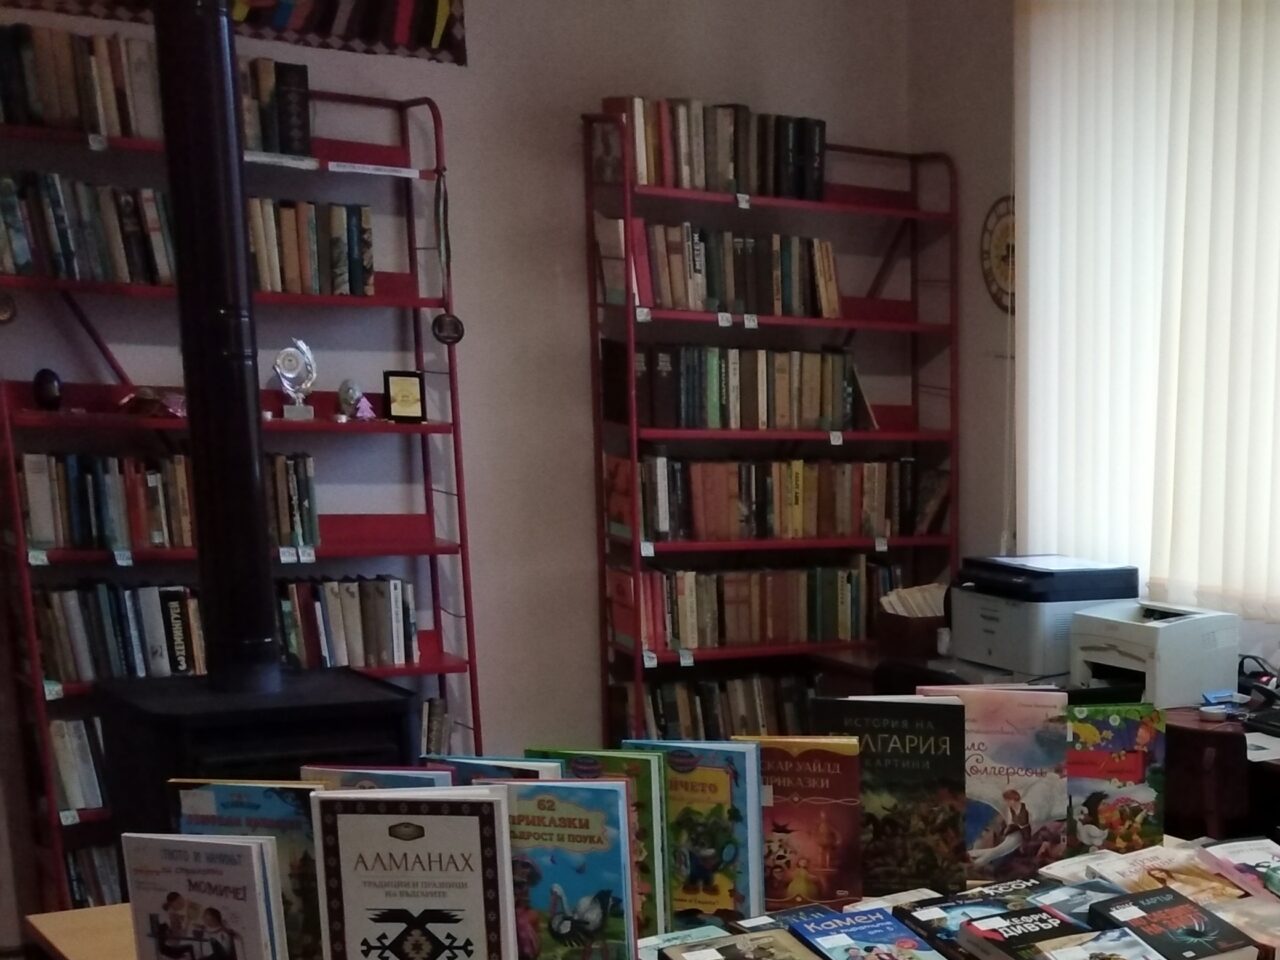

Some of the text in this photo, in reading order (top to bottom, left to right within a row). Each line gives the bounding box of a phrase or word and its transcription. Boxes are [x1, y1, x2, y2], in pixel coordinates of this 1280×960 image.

[914, 717, 936, 731] НА
[829, 731, 952, 756] ЛГАРИЯ
[760, 759, 796, 775] СКАР
[536, 799, 556, 811] 62
[510, 830, 553, 843] ЪДРОСТ
[353, 851, 476, 873] АЛМАНАХ
[803, 910, 884, 933] Камен
[1004, 910, 1053, 928] ЖЕФРИ
[999, 918, 1062, 939] ДИВЪР
